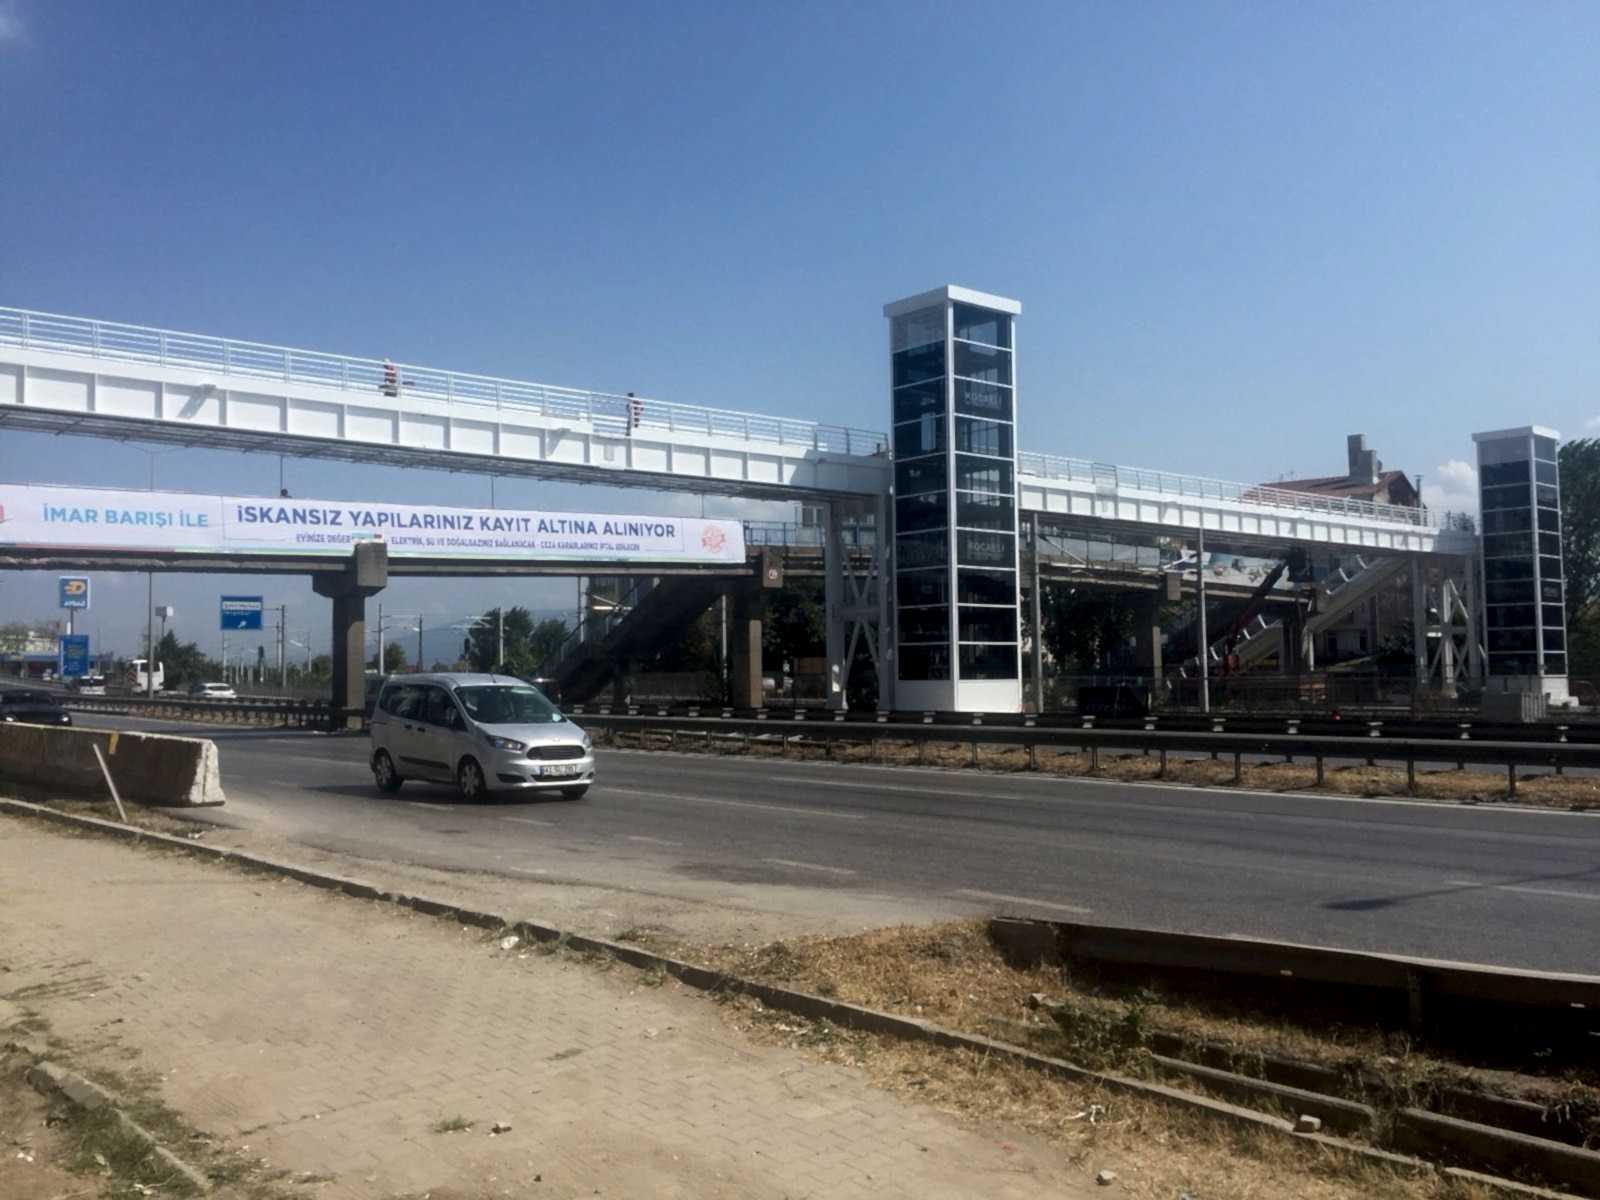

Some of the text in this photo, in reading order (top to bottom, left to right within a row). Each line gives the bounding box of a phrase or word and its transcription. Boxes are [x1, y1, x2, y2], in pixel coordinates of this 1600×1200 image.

[43, 503, 208, 528] İMAR BARIŞI İLE
[238, 505, 675, 537] İSKANSIZ YAPILARINIZ KAYIT ALTINA ALINIYOR
